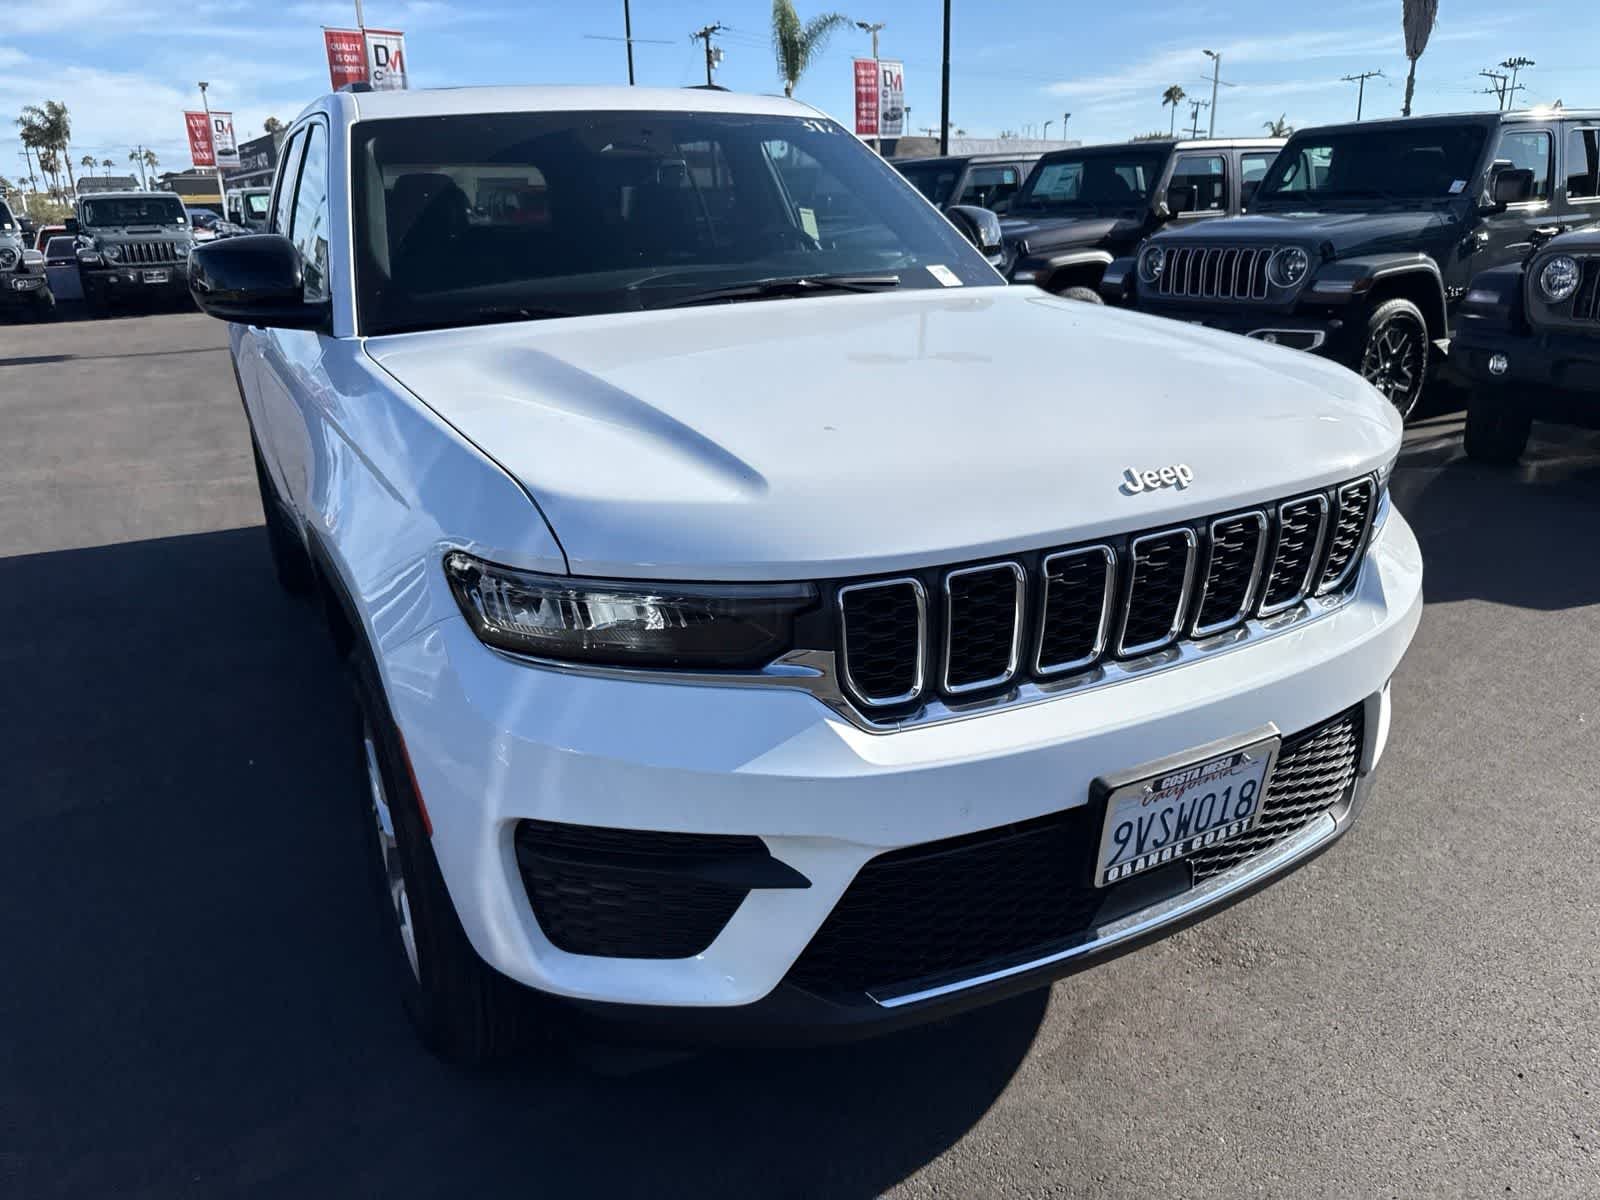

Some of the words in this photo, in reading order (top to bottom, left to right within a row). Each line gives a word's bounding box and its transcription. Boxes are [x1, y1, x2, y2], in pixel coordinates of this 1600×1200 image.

[330, 43, 361, 52] QUALITY
[1119, 464, 1193, 496] Jeep
[1161, 768, 1201, 790] COSTA
[1201, 757, 1233, 776] MESA
[1107, 779, 1257, 868] 9VSW018
[1107, 842, 1184, 882] ORANGE
[1192, 819, 1250, 851] COAST
